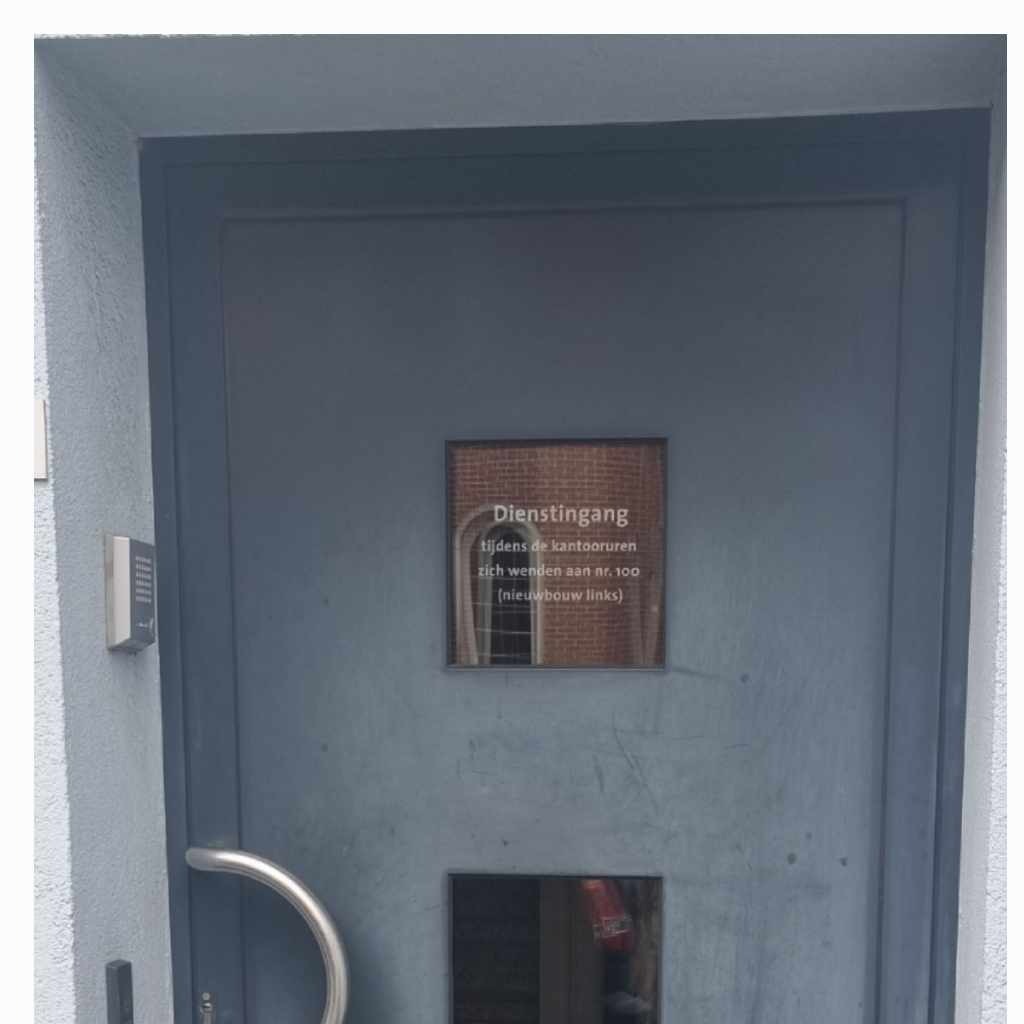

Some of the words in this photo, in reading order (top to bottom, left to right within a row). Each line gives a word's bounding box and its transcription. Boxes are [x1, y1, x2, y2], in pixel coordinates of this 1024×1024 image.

[494, 505, 629, 527] Dienstingang
[481, 540, 528, 555] tijdens
[531, 540, 548, 551] de
[552, 540, 637, 551] kantooruren
[478, 564, 504, 576] zich
[508, 564, 562, 576] wenden
[566, 567, 591, 576] aan
[595, 567, 612, 576] nr.
[616, 567, 640, 577] 100
[498, 588, 583, 604] (nieuwbouw
[586, 588, 624, 604] links)
